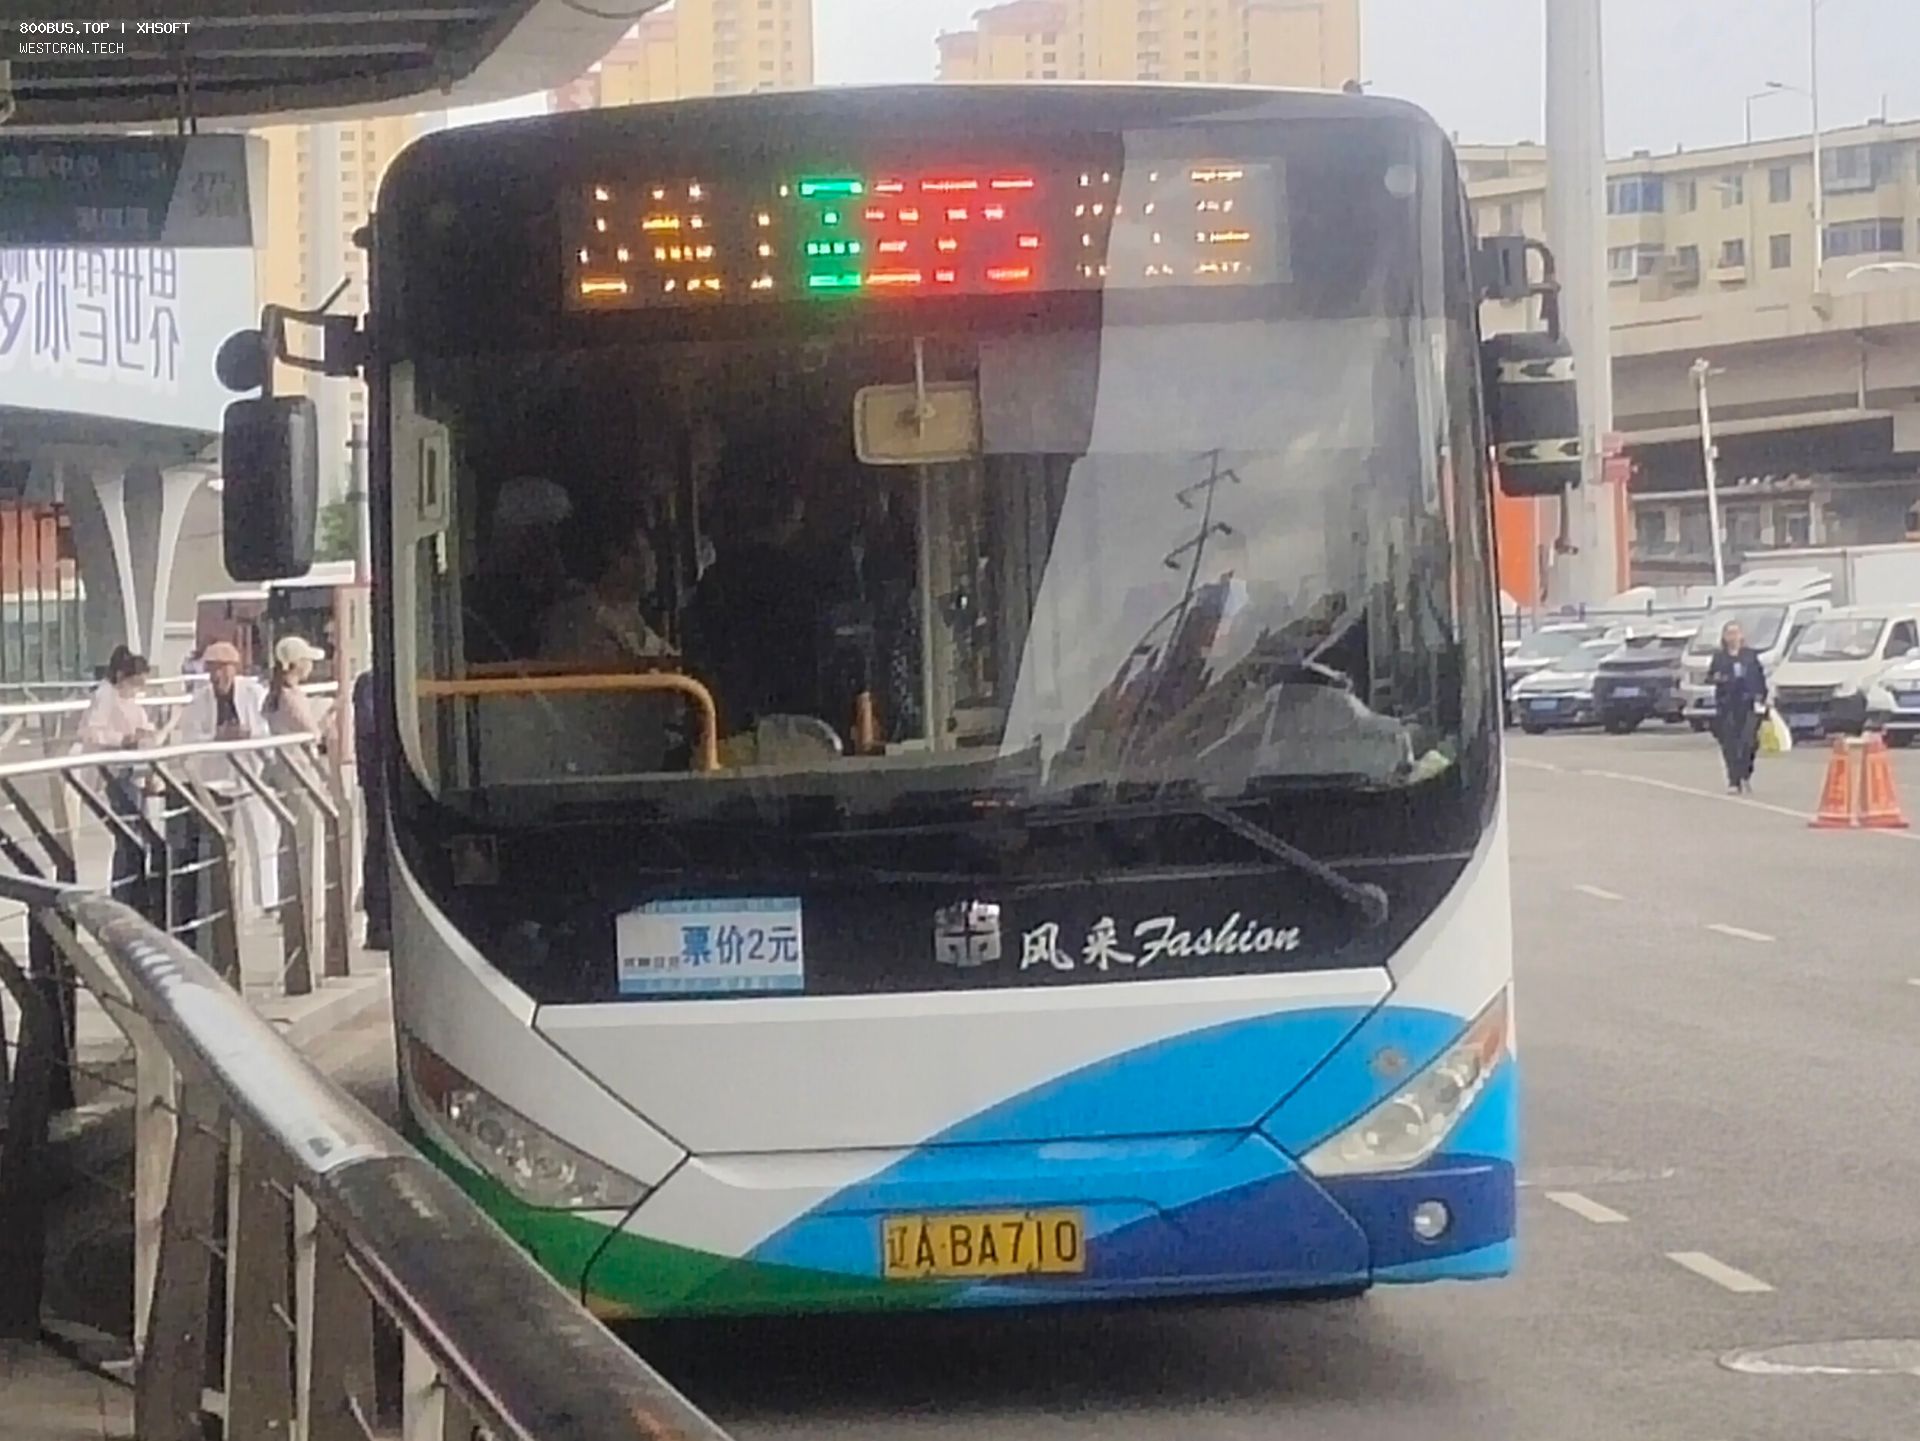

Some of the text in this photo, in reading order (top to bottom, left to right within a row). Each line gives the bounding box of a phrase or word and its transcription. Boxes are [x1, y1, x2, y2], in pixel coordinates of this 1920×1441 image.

[681, 925, 798, 966] 票价2元
[1020, 911, 1300, 970] 风采 Fashion
